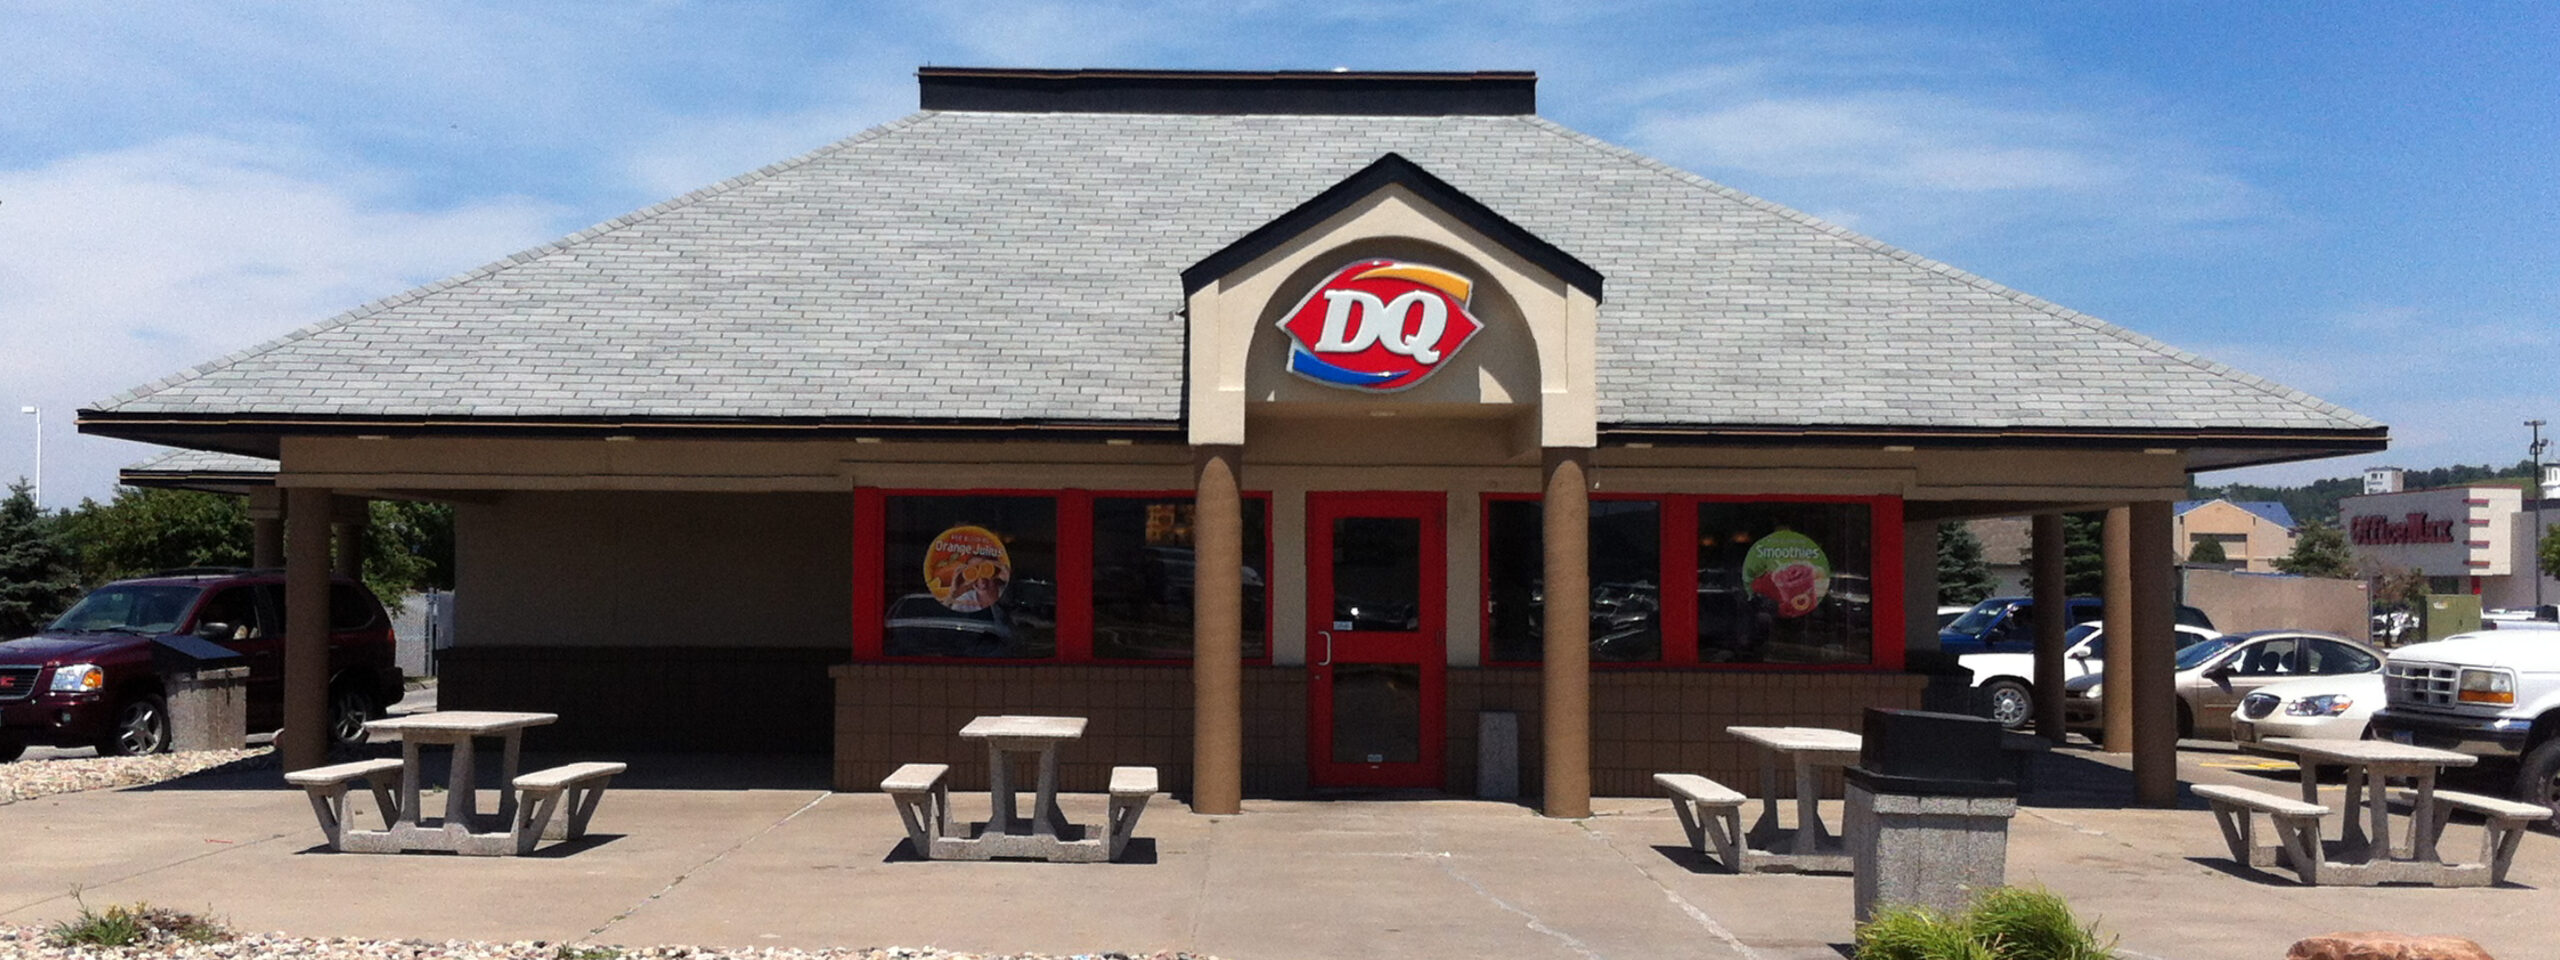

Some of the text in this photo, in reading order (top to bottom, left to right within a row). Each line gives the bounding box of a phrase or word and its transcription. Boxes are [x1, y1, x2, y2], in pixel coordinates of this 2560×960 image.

[1314, 289, 1448, 365] DQ
[936, 540, 1002, 557] Orange Julius
[1756, 545, 1820, 559] Smoothies
